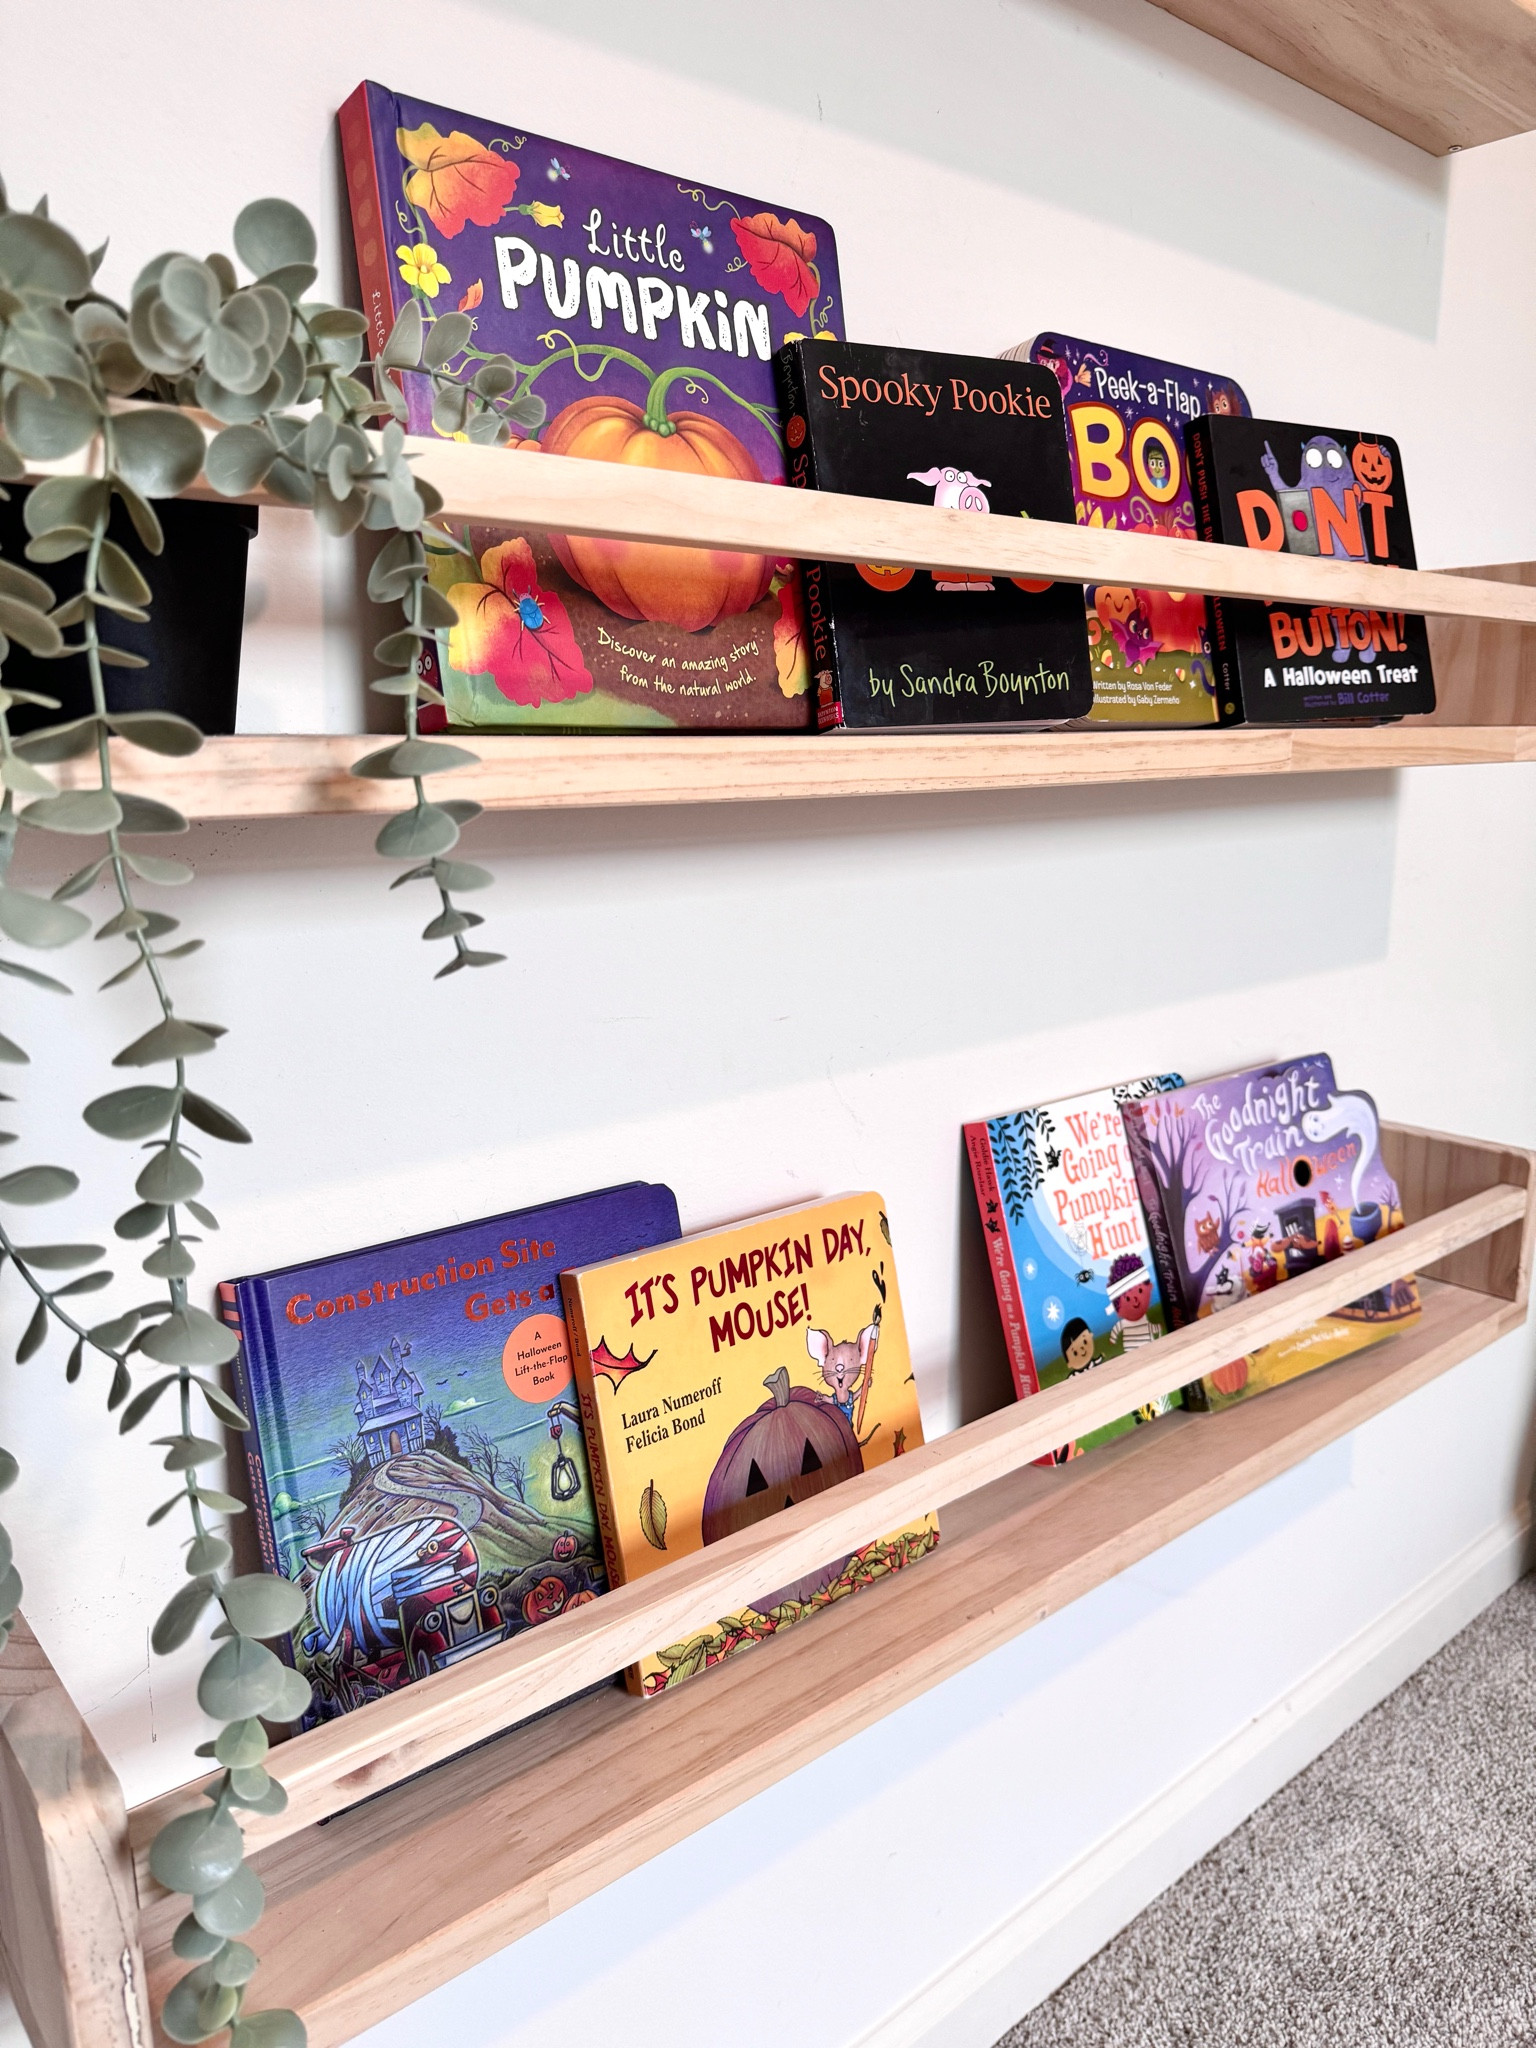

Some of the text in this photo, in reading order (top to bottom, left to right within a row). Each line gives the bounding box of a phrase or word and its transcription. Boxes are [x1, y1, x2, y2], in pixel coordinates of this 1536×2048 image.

[582, 208, 685, 273] Little
[372, 289, 386, 347] Little
[780, 349, 799, 410] Boynton
[818, 364, 1052, 419] Spooky Pookie
[1094, 366, 1201, 420] Peek-a-Flap
[1069, 402, 1191, 504] BO
[806, 565, 828, 661] Pookie
[1213, 596, 1227, 651] LLOWEEN
[1268, 606, 1408, 659] BUTTON!
[597, 626, 759, 672] Discover an amazing story
[619, 664, 757, 697] from the natural world.
[869, 661, 1069, 708] by Sandra Boynton
[1117, 681, 1126, 692] by
[1126, 682, 1142, 691] Rosa
[1143, 682, 1155, 691] Von
[1155, 682, 1173, 691] Feder
[1127, 694, 1137, 706] by
[1137, 694, 1153, 707] Gaby
[1222, 662, 1231, 690] Cotter
[1264, 664, 1419, 688] A Halloween Treat
[1337, 692, 1355, 705] Bill
[1357, 691, 1390, 704] Cotter
[1064, 1110, 1122, 1148] We're
[1191, 1092, 1222, 1121] The
[1204, 1070, 1320, 1165] Goodnight
[1062, 1143, 1122, 1185] Going
[1233, 1125, 1304, 1177] Train
[1087, 1210, 1142, 1261] Hunt
[284, 1256, 495, 1326] Construction
[499, 1238, 557, 1270] Site
[624, 1273, 679, 1327] IT'S
[690, 1233, 814, 1307] PUMPKIN
[822, 1218, 872, 1265] DAY,
[464, 1283, 556, 1322] Gets a
[708, 1282, 813, 1353] MOUSE!
[992, 1237, 1004, 1267] We're
[999, 1269, 1013, 1302] Going
[1009, 1321, 1027, 1371] Pumpkin
[1019, 1373, 1033, 1399] Hun
[517, 1341, 562, 1361] Halloween
[534, 1331, 542, 1341] A
[514, 1354, 568, 1377] Lift-the-Flap
[532, 1372, 555, 1386] Book
[580, 1393, 595, 1420] IT'S
[620, 1376, 723, 1430] Laura Numeroff
[625, 1408, 706, 1453] Felicia Bond
[247, 1452, 257, 1490] Gets
[586, 1427, 606, 1498] PUMPKIN
[255, 1455, 275, 1563] Construction
